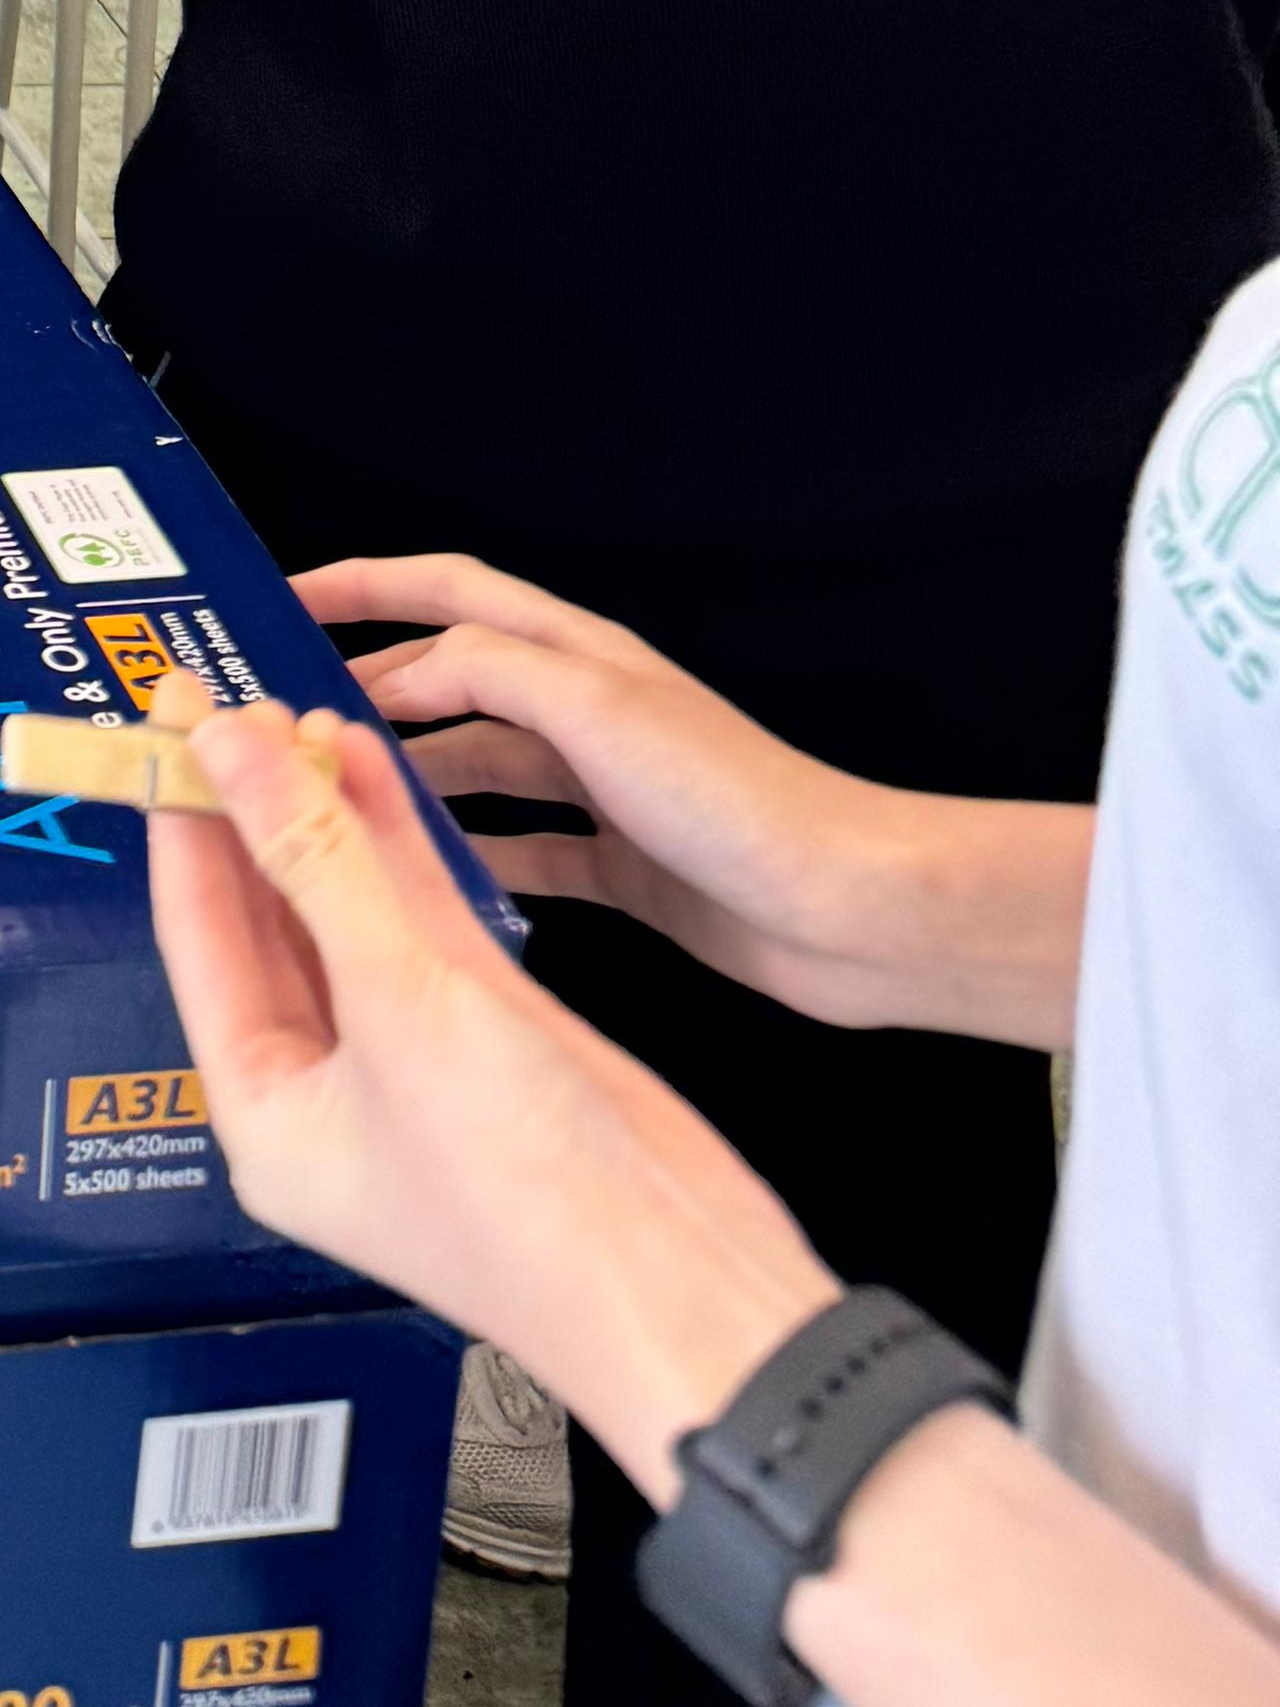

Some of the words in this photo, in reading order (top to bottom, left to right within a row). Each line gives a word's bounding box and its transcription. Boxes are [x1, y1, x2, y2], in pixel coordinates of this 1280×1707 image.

[24, 606, 90, 672] Only
[193, 608, 239, 654] sheets
[63, 678, 111, 703] &
[217, 656, 268, 703] 5x500
[79, 1075, 198, 1127] A3L
[64, 1133, 206, 1164] 297x420mm
[62, 1166, 131, 1196] 5x500
[134, 1164, 207, 1189] sheets
[196, 1636, 302, 1679] A3L
